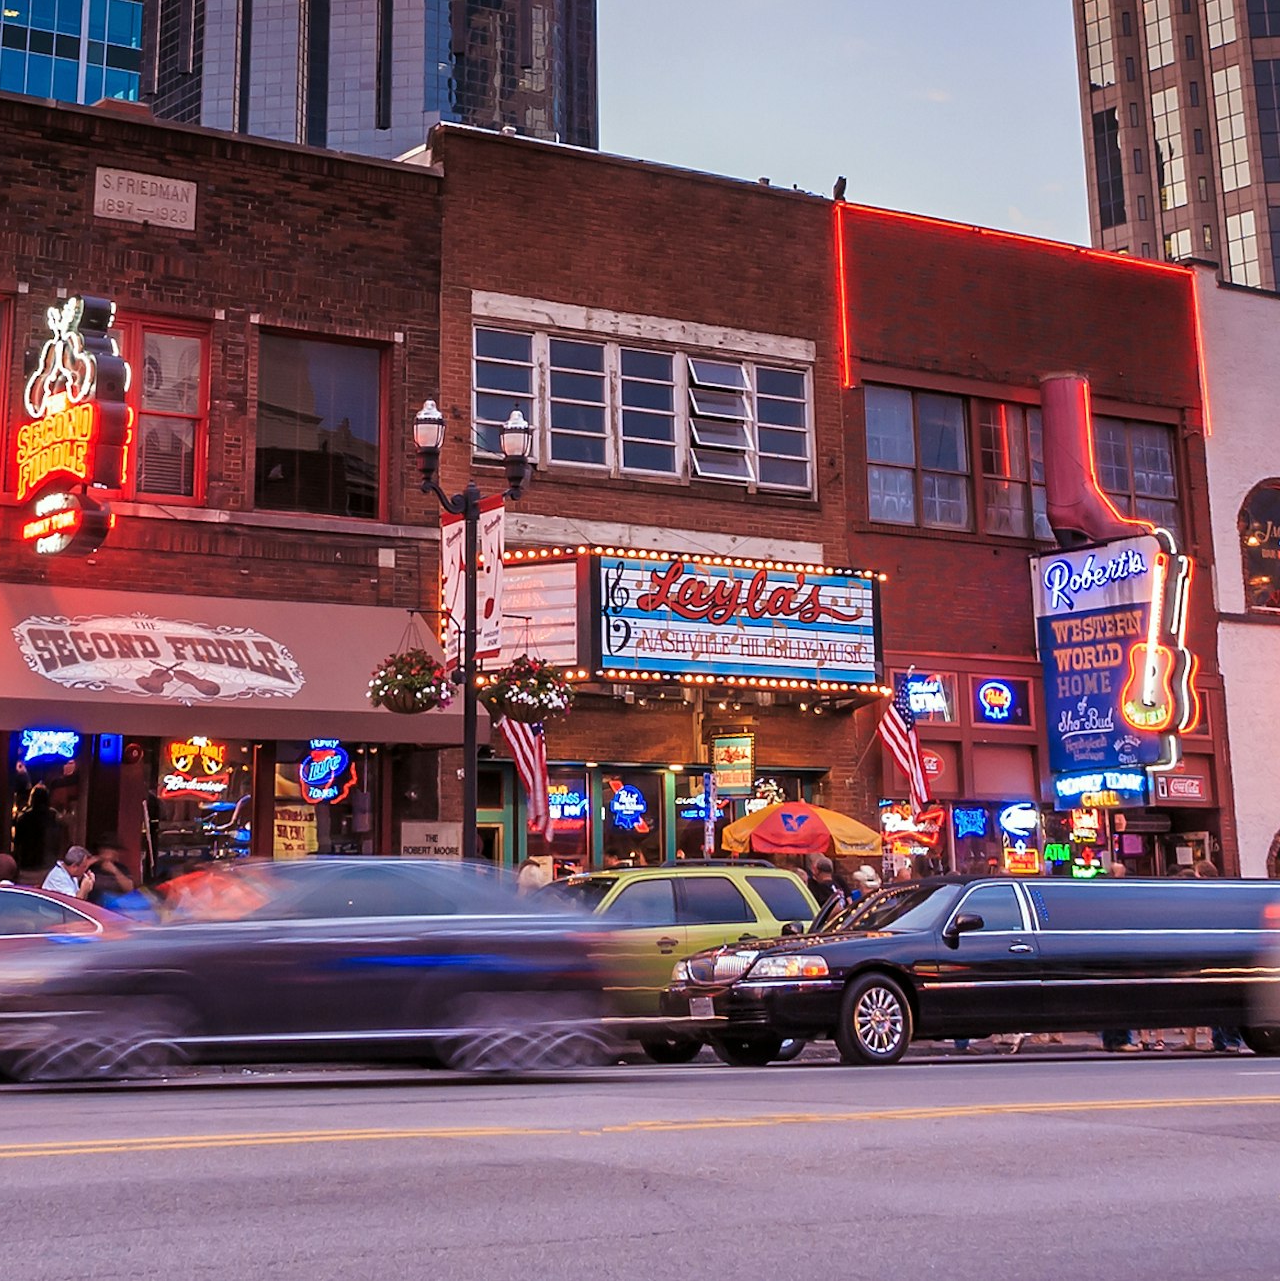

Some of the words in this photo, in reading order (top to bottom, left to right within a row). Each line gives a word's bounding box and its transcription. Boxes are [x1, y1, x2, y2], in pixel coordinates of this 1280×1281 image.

[17, 403, 94, 463] SECOND
[17, 440, 88, 500] FIDDLE
[637, 560, 864, 625] Layla's
[1044, 549, 1148, 609] Robert's
[132, 620, 158, 631] THE
[1051, 610, 1144, 644] WESTERN
[27, 627, 161, 673] SECOND
[165, 635, 297, 686] FIDDLE
[640, 629, 732, 656] NASHVILLE
[738, 637, 814, 659] HILLBILLY
[818, 642, 868, 664] MUSIC
[1053, 642, 1123, 673] WORLD
[1056, 671, 1112, 698] HOME
[1058, 707, 1115, 733] Sho-Bud
[1081, 790, 1120, 807] GRILL
[403, 846, 431, 855] ROBERT
[434, 846, 460, 856] MOORE
[424, 834, 439, 843] THE
[1044, 844, 1071, 861] ATM
